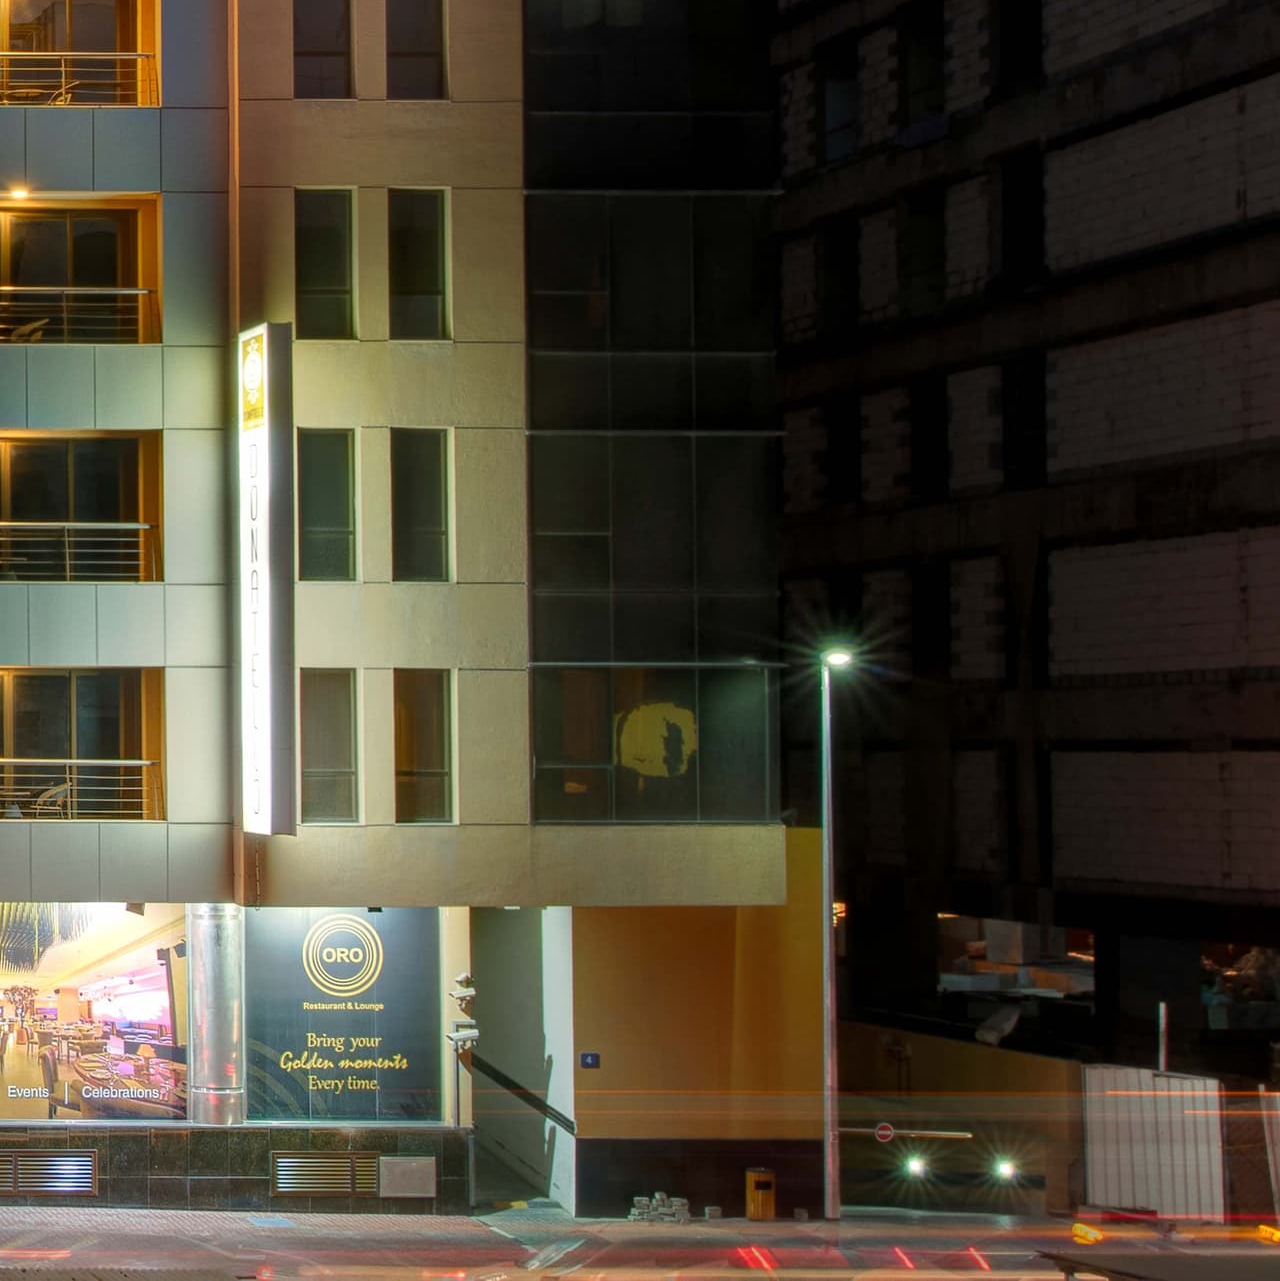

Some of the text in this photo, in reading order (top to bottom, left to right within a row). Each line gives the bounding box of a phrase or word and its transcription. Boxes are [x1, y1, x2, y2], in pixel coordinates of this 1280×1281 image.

[322, 947, 364, 963] ORO
[303, 1002, 346, 1010] Restaurant
[354, 1002, 385, 1012] Lounge
[306, 1032, 382, 1053] Bring your
[279, 1051, 408, 1072] Golden moments
[7, 1085, 50, 1098] Events
[81, 1086, 160, 1099] Celebrations
[308, 1075, 380, 1095] Every time.
